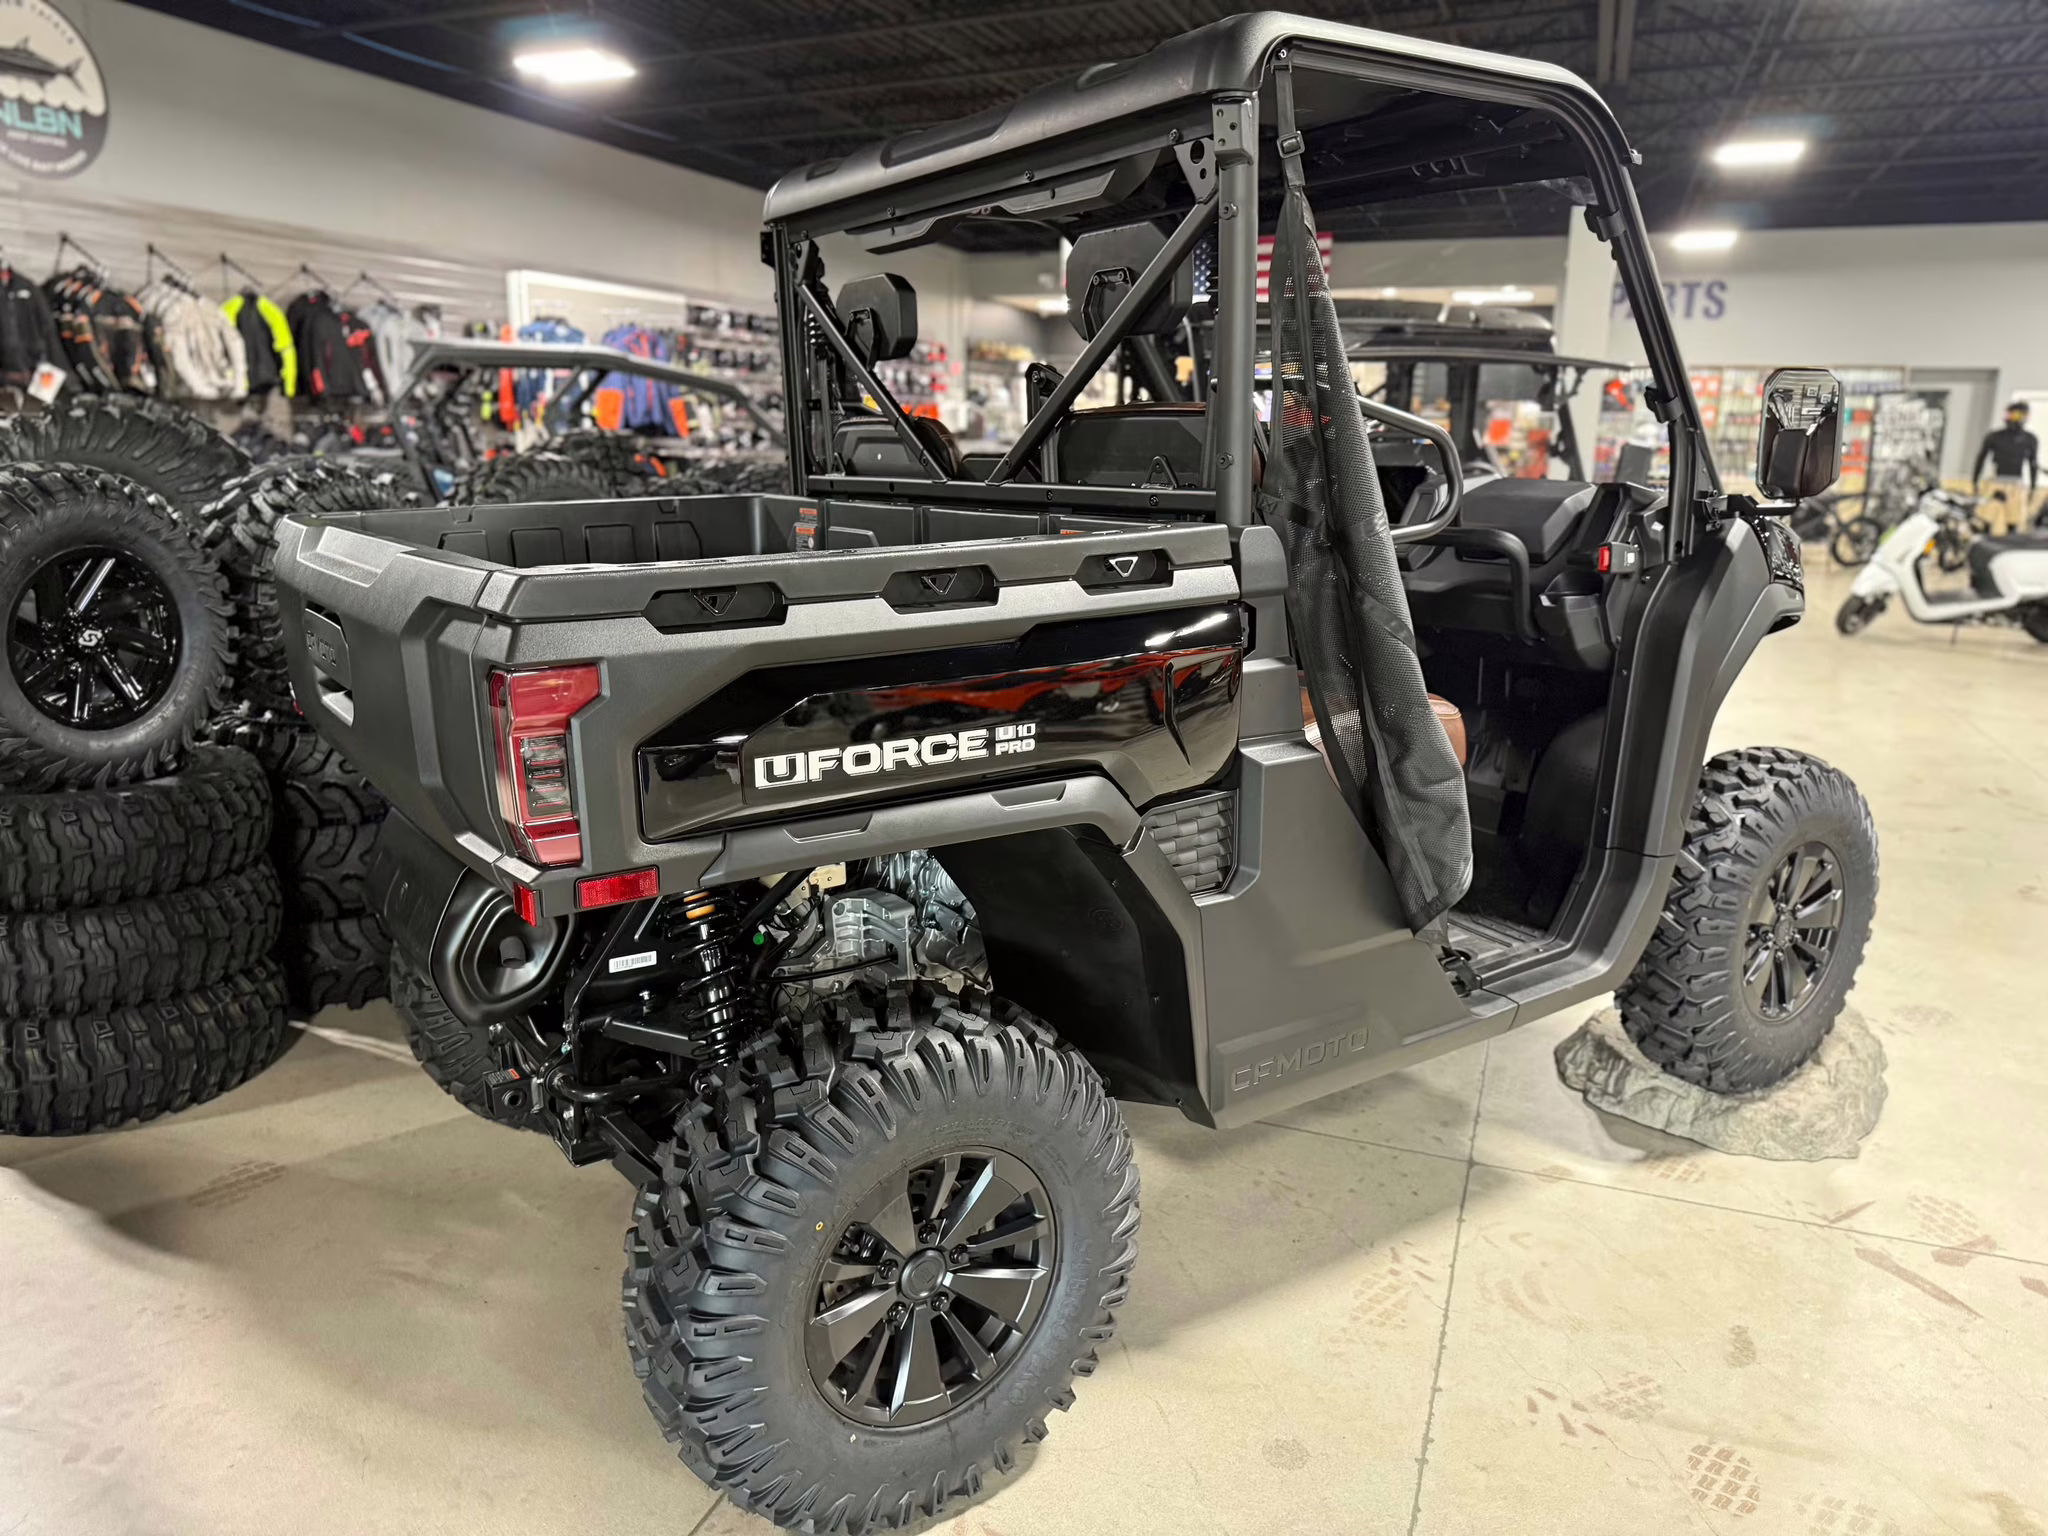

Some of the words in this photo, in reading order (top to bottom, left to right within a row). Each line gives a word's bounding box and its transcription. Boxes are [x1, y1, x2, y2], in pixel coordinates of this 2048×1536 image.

[1609, 280, 1728, 321] PRTS
[754, 728, 990, 789] UFORCE
[995, 723, 1036, 742] U10
[995, 738, 1036, 756] PRO
[1233, 1026, 1371, 1092] CFMOTO
